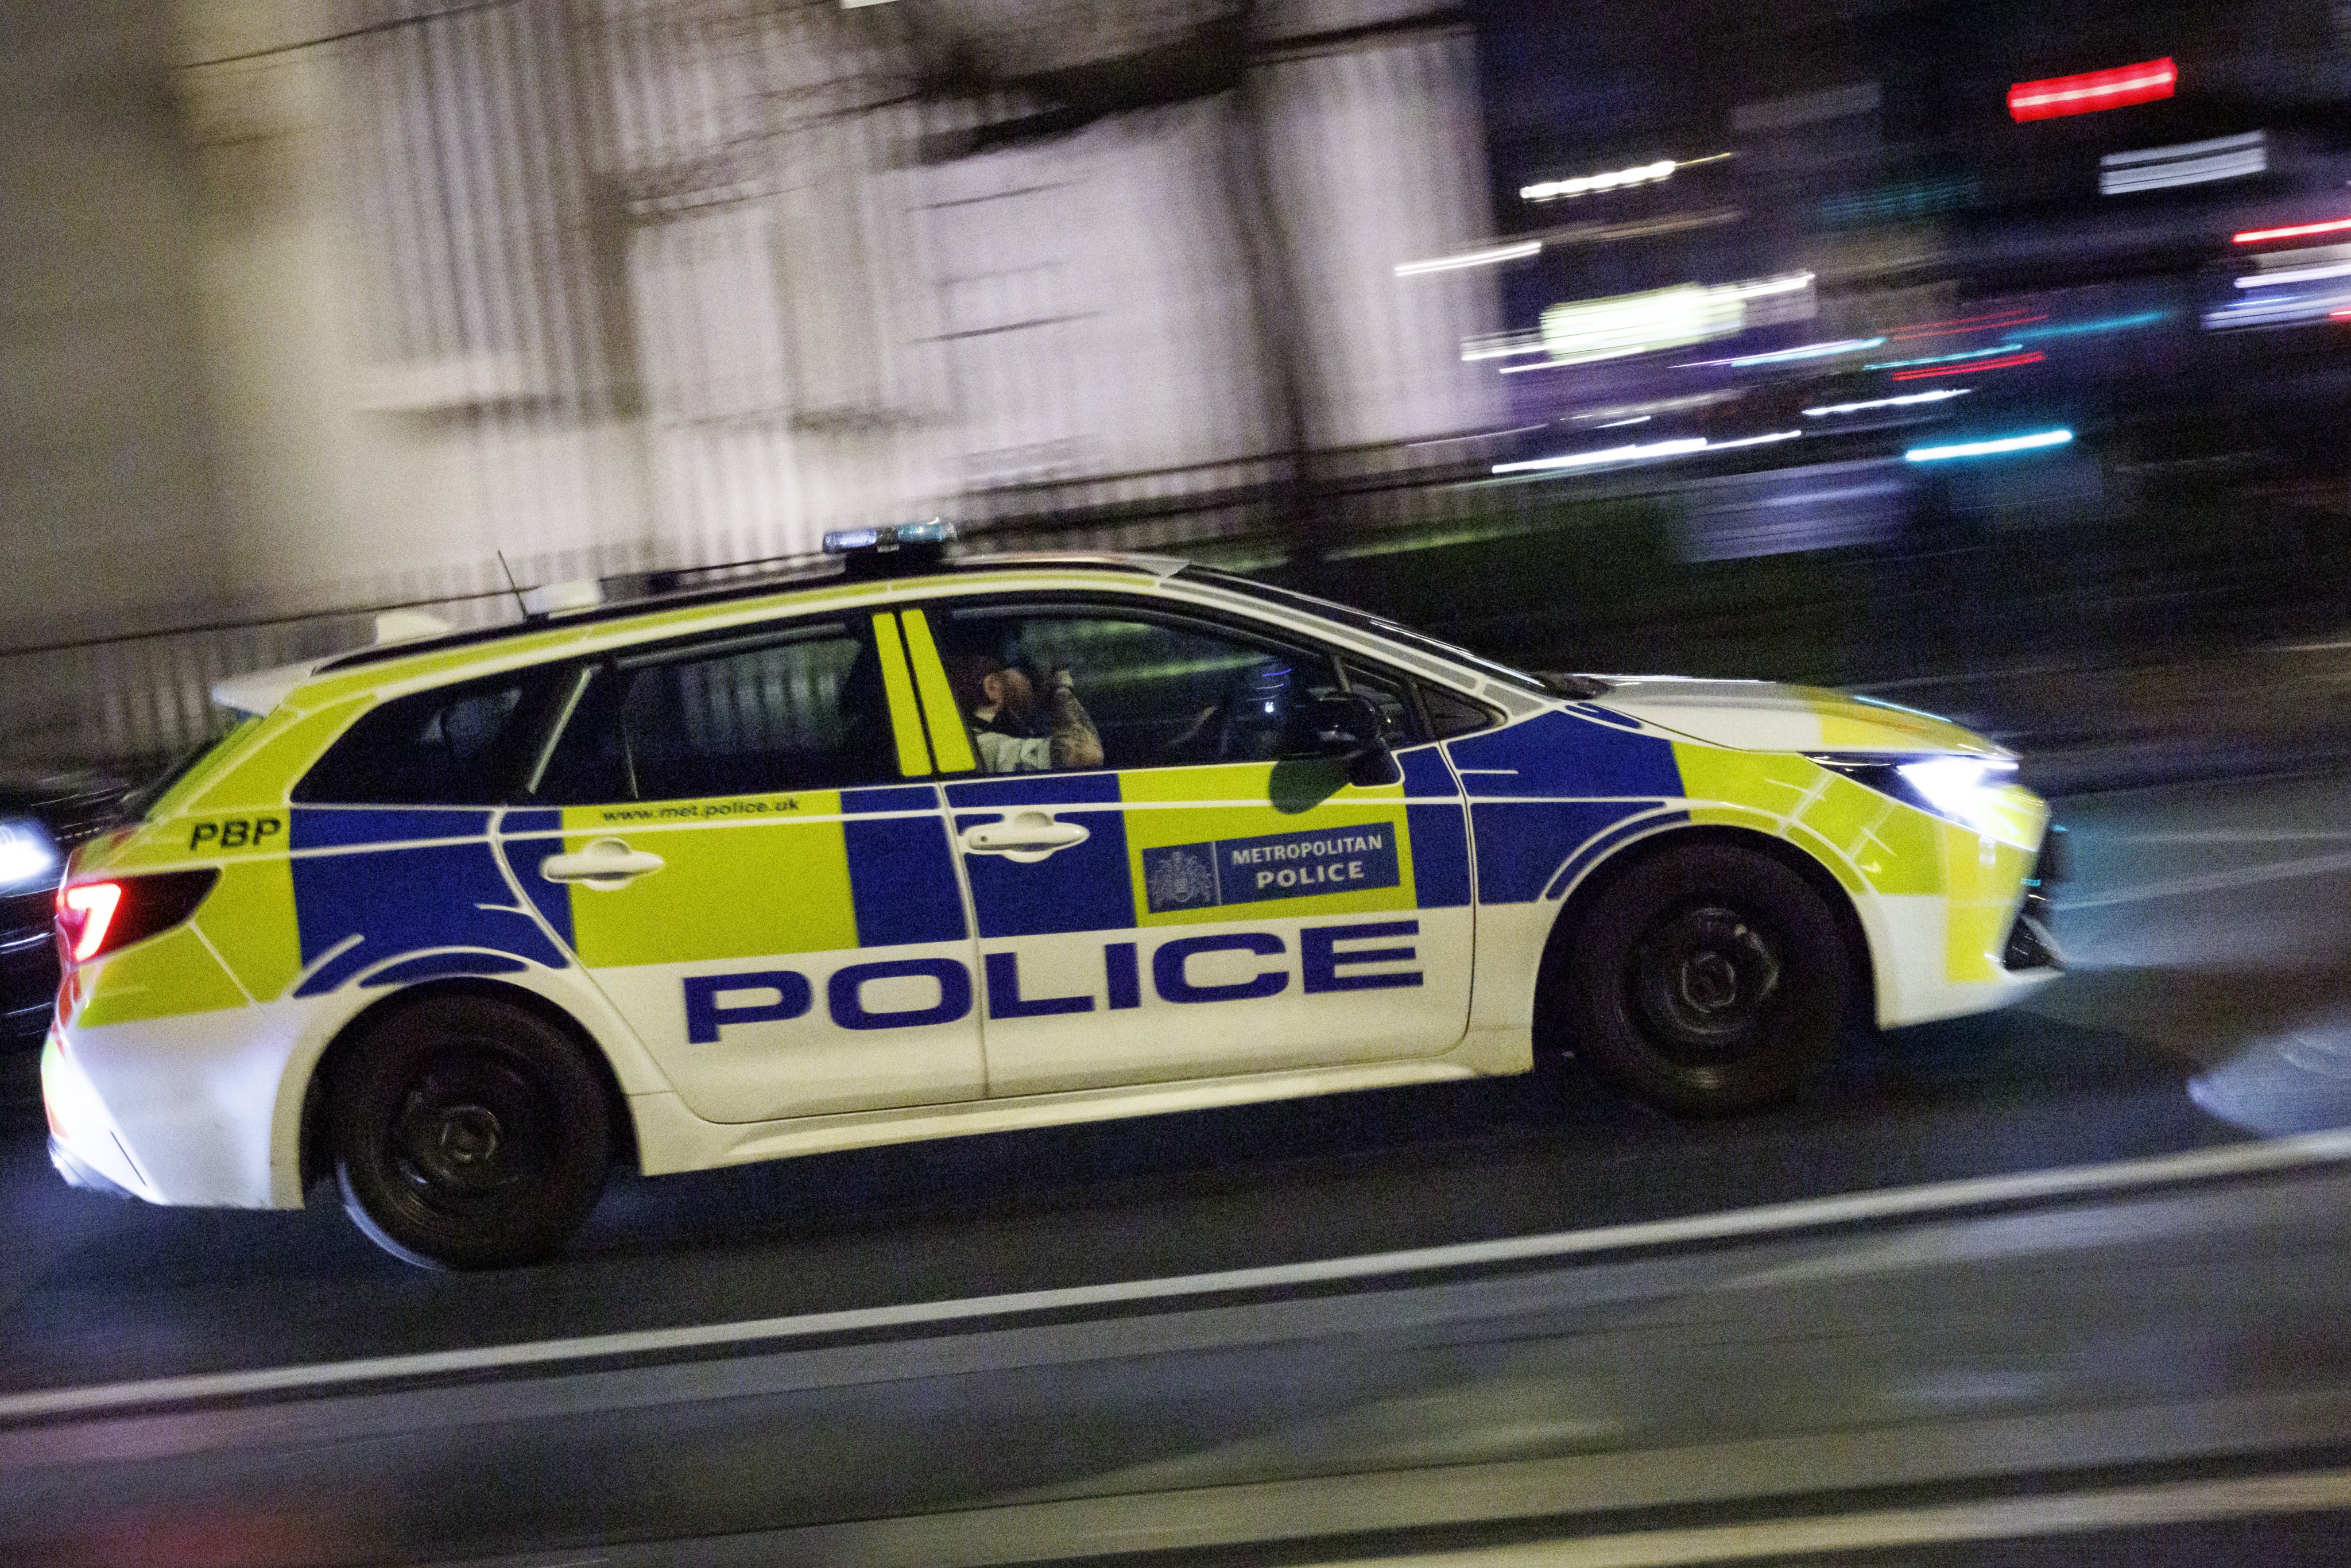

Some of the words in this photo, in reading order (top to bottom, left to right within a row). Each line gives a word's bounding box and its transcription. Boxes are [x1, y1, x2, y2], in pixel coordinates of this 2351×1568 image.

[603, 798, 799, 821] www.met.police.uk
[189, 816, 281, 851] PBP
[1231, 834, 1382, 865] METROPOLITAN
[1256, 861, 1365, 889] POLICE
[683, 919, 1424, 1044] POLICE
